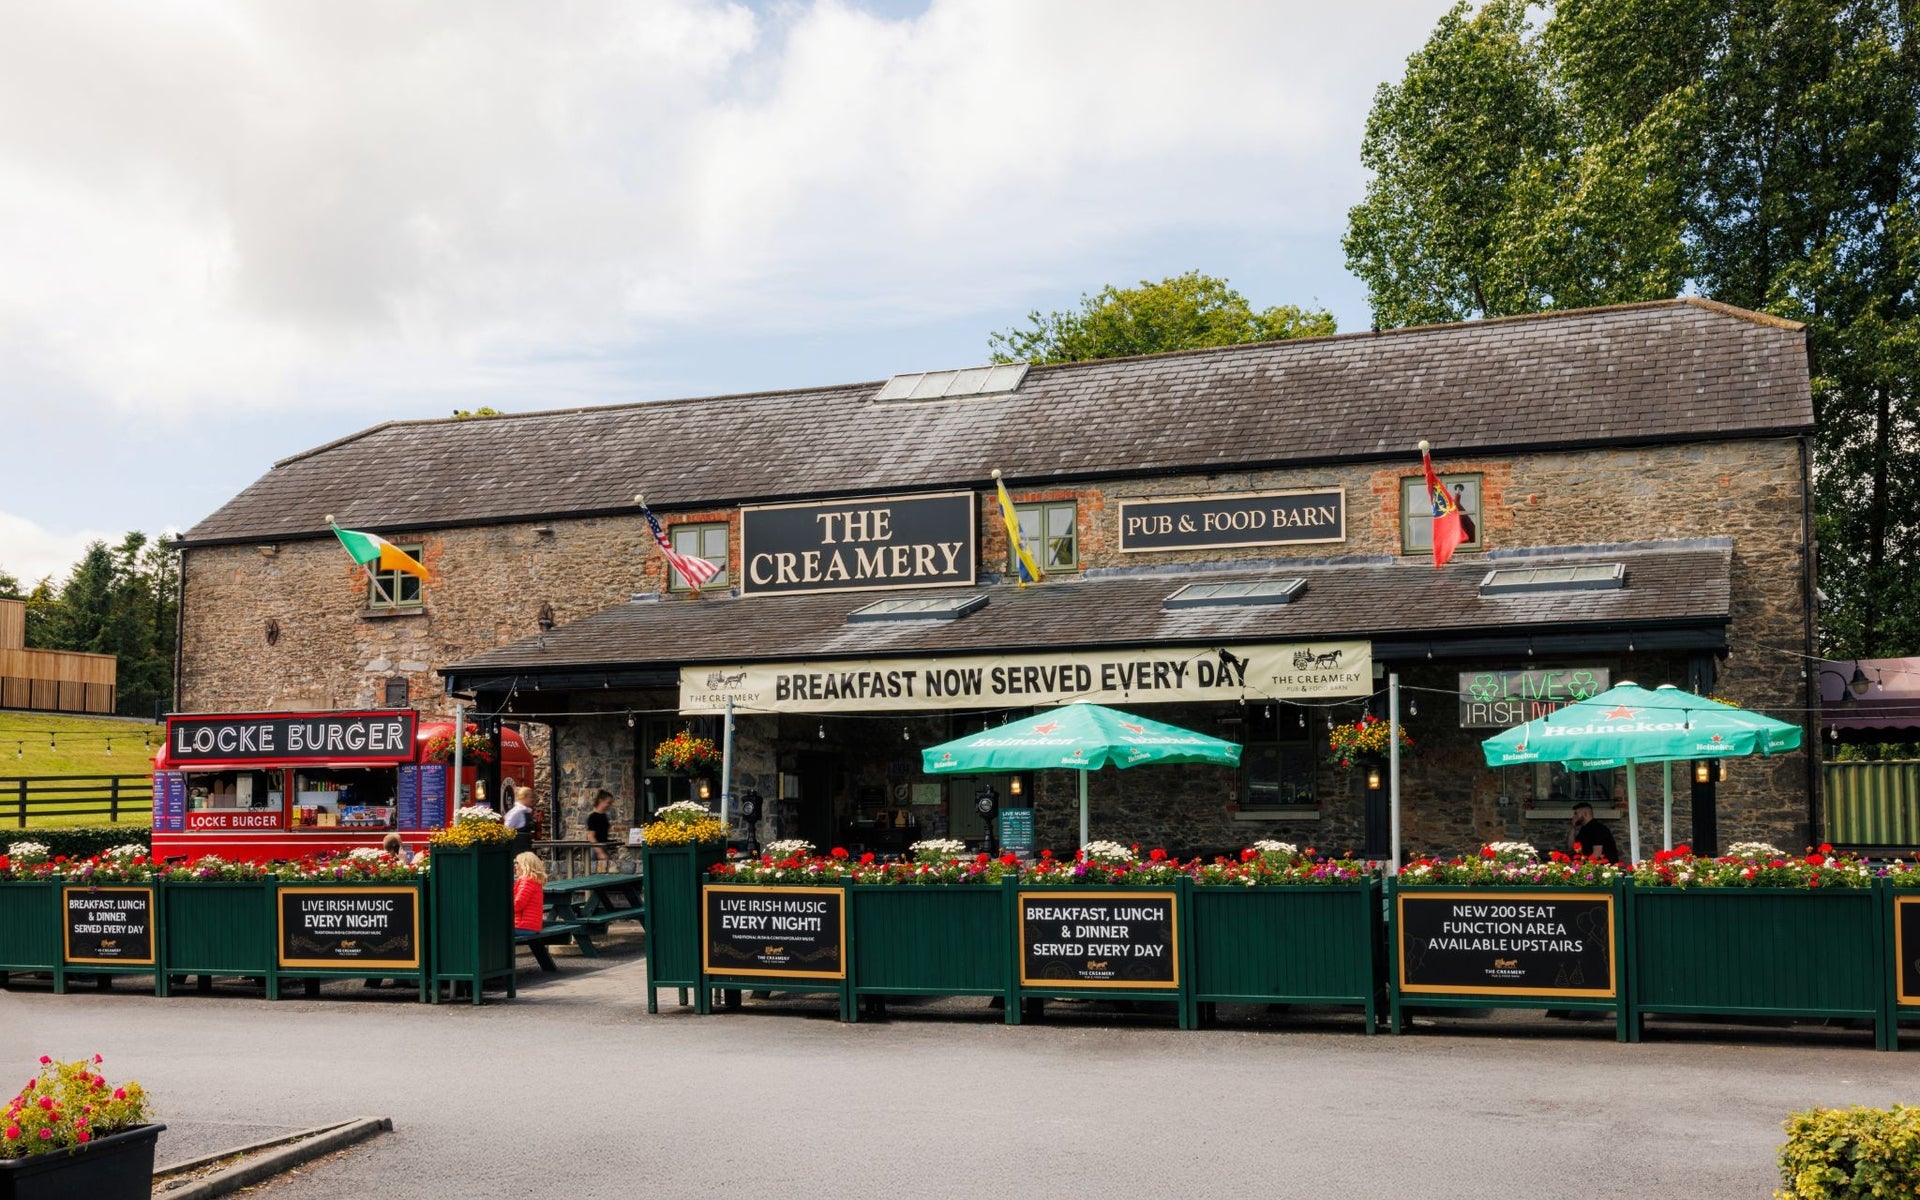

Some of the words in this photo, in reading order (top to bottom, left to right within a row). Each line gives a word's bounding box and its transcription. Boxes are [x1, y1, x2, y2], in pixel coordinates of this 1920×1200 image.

[816, 509, 893, 544] THE
[1127, 515, 1172, 536] PUB
[1178, 514, 1198, 533] &
[1203, 510, 1266, 532] FOOD
[1271, 506, 1336, 528] BARN
[750, 542, 963, 585] CREAMERY
[776, 670, 917, 700] BREAKFAST
[926, 668, 983, 697] NOW
[991, 664, 1091, 694] SERVED
[1101, 660, 1187, 691] EVERY
[1197, 658, 1249, 688] DAY
[1272, 675, 1293, 684] THE
[1297, 673, 1360, 683] CREAMERY
[1503, 673, 1565, 701] LIVE
[709, 693, 760, 702] CREMERY
[1467, 701, 1524, 724] IRISH
[1542, 717, 1697, 738] Heineken
[177, 725, 275, 753] LOCKE
[287, 723, 404, 750] BURGER
[1696, 742, 1736, 751] Heineken
[1502, 751, 1539, 761] Heineken
[1582, 758, 1614, 767] Heineken
[191, 816, 227, 827] LOCKE
[232, 815, 277, 827] BURGER
[69, 899, 116, 910] BREAKFAST,
[117, 900, 146, 910] LUNCH
[302, 900, 324, 911] LIVE
[326, 900, 354, 911] IRISH
[356, 900, 394, 911] MUSIC
[720, 900, 746, 911] LIVE
[749, 900, 781, 912] IRISH
[784, 901, 827, 913] MUSIC
[88, 912, 95, 921] &
[96, 912, 127, 921] DINNER
[1026, 907, 1110, 921] BREAKFAST,
[1114, 908, 1164, 921] LUNCH
[1453, 905, 1488, 918] NEW
[1491, 906, 1517, 918] 200
[1518, 906, 1556, 919] SEAT
[305, 914, 342, 928] EVERY
[346, 914, 388, 928] NIGHT!
[722, 915, 768, 930] EVERY
[772, 916, 821, 931] NIGHT!
[74, 924, 102, 933] SERVED
[103, 925, 127, 934] EVERY
[127, 925, 145, 934] DAY
[1061, 925, 1071, 938] &
[1075, 925, 1129, 938] DINNER
[1443, 921, 1523, 935] FUNCTION
[1525, 923, 1567, 936] AREA
[1033, 943, 1084, 956] SERVED
[1087, 944, 1131, 956] EVERY
[1134, 944, 1164, 957] DAY
[1428, 938, 1508, 951] AVAILABLE
[1511, 939, 1583, 952] UPSTAIRS
